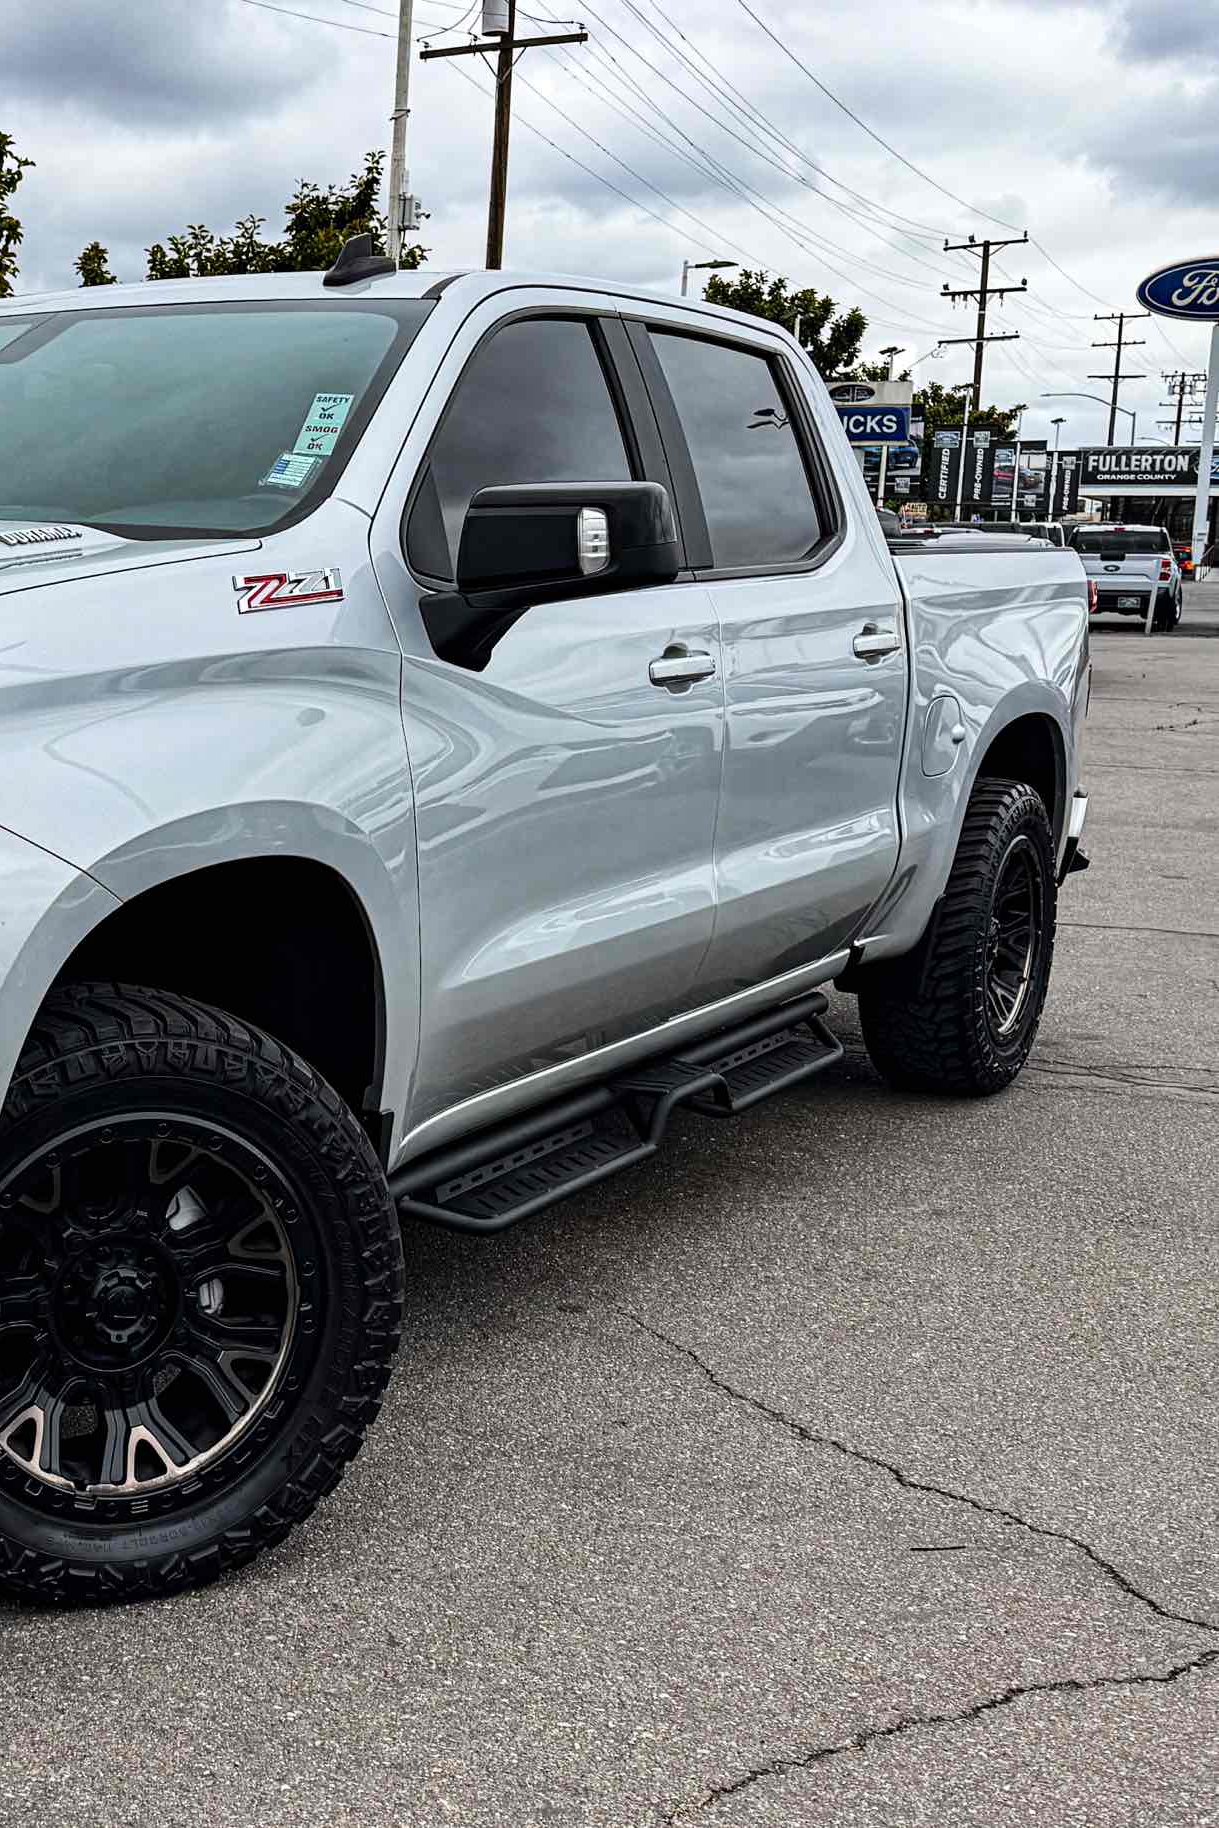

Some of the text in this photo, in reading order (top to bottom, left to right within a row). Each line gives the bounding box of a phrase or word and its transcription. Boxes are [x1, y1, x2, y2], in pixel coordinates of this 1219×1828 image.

[315, 395, 351, 404] SAFETY
[318, 412, 335, 420] OK
[304, 424, 339, 433] SMOG
[307, 442, 324, 451] OK
[1087, 455, 1190, 473] FULLERTON
[937, 448, 951, 500] CERTIFIED
[973, 448, 985, 500] PRE-OWNED
[231, 567, 345, 615] Z71
